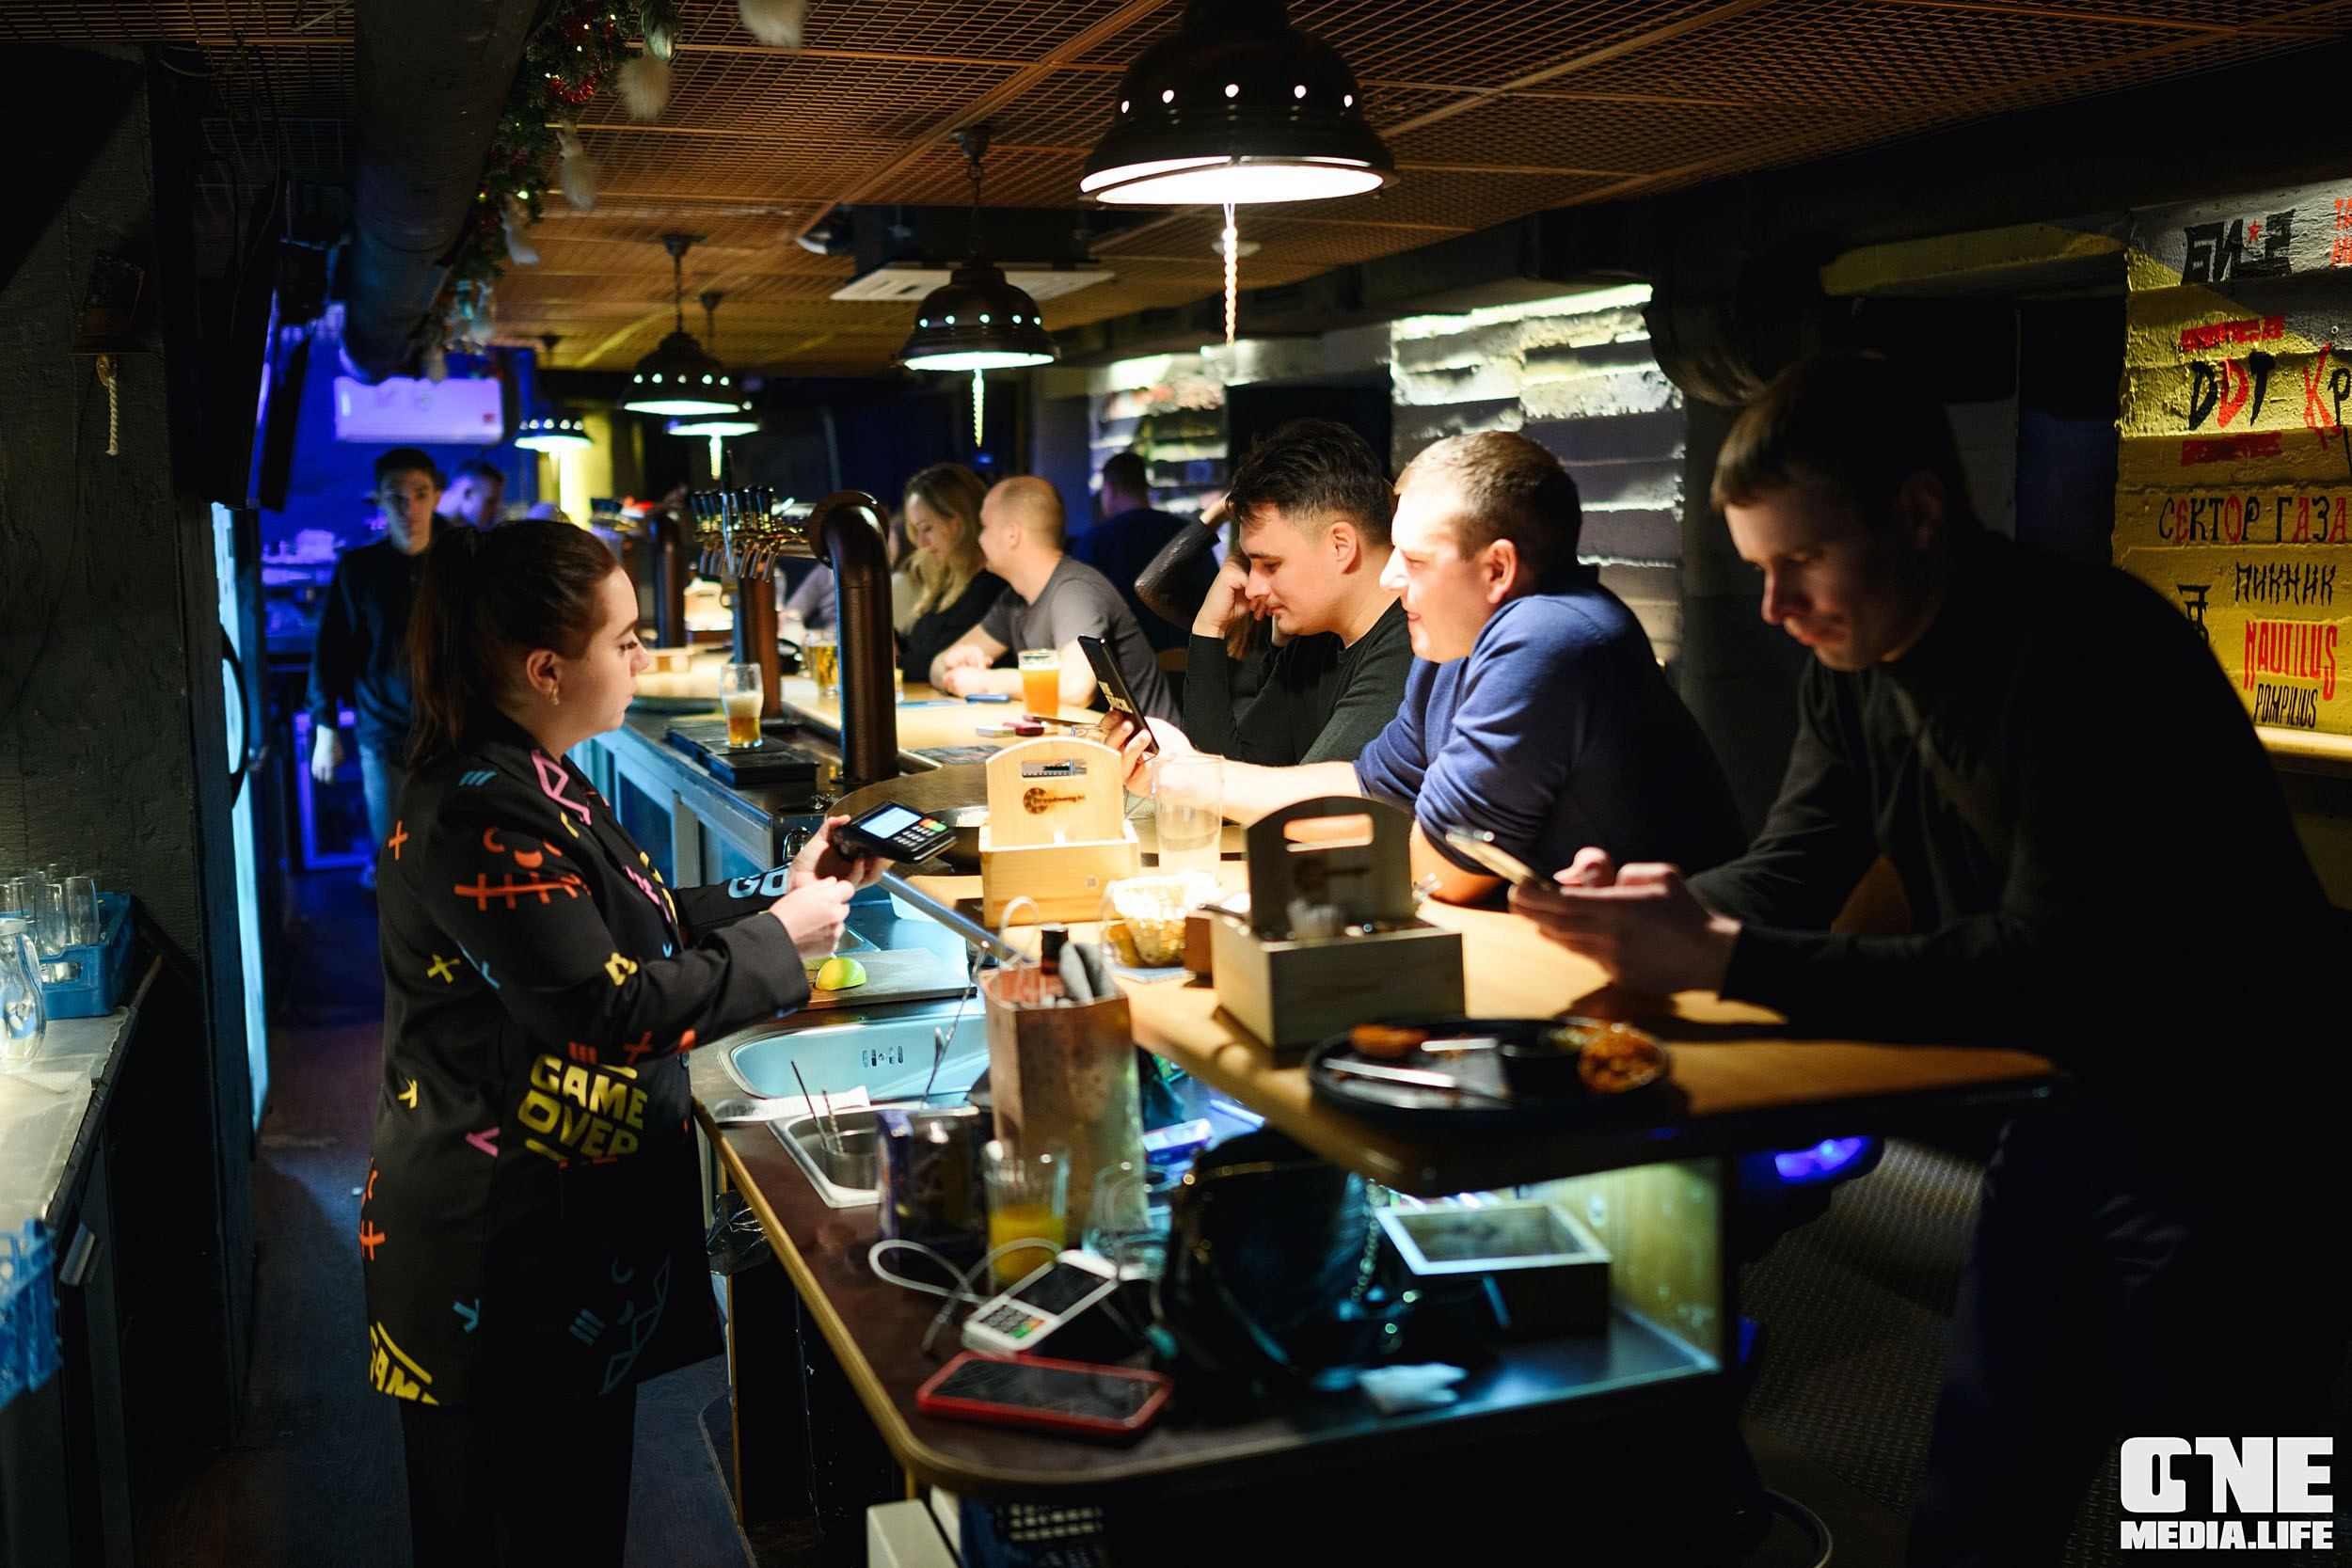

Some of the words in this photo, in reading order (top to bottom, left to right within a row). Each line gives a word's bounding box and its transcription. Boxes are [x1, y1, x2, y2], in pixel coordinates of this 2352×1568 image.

[2158, 494, 2259, 543] СЕКТОР
[2275, 496, 2347, 544] ГАЗА
[2235, 562, 2336, 607] ПИКНИК
[2243, 620, 2338, 702] NAUTILUS
[2254, 683, 2319, 729] POMPILIUS
[530, 1053, 649, 1130] GAME
